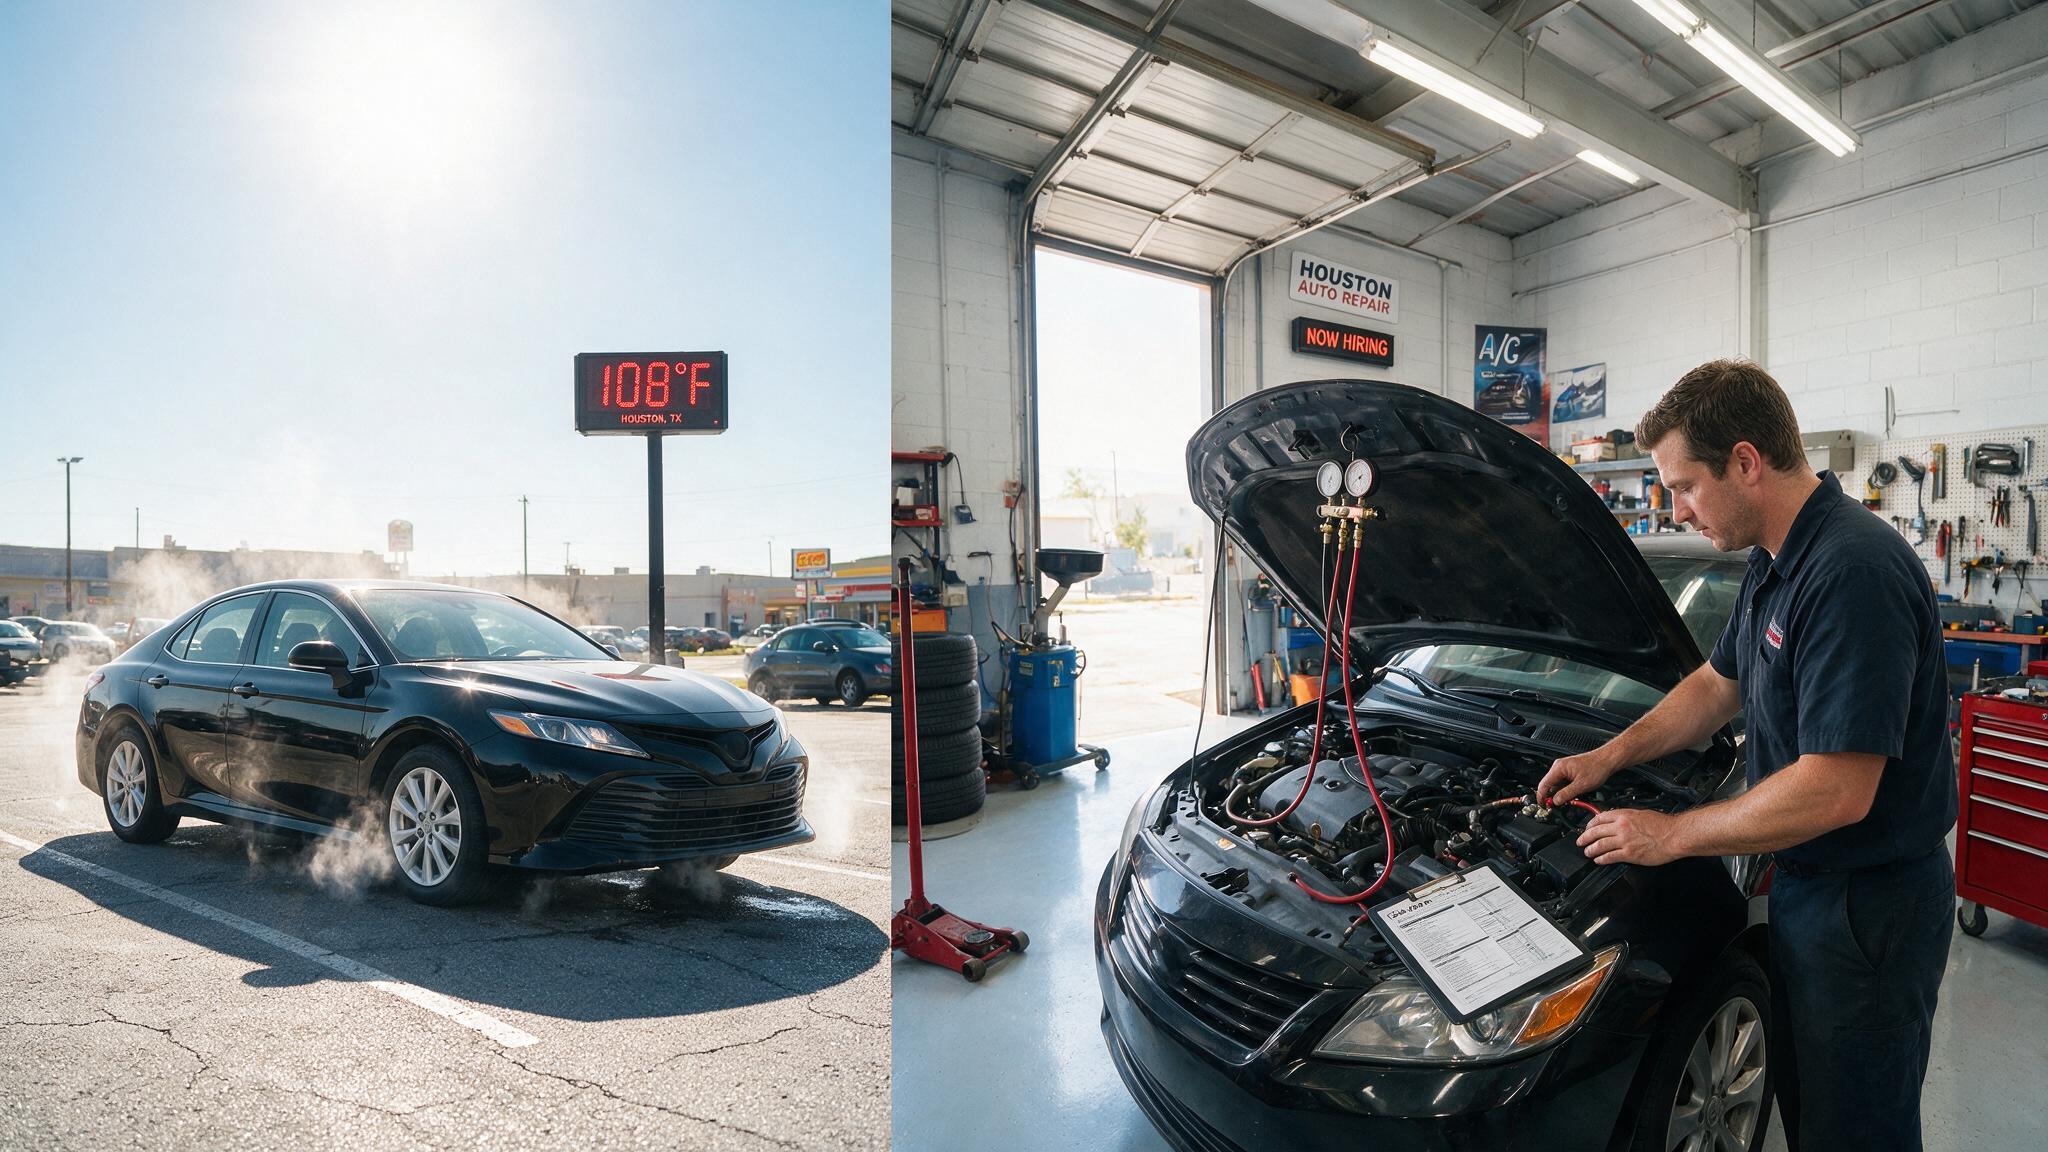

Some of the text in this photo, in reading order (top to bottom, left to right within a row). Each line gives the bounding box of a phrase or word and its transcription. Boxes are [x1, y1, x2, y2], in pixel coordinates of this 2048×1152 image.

[1298, 279, 1390, 314] AUTO REPAIR
[1300, 259, 1392, 300] HOUSTON
[1306, 327, 1388, 356] NOW HIRING
[602, 361, 710, 408] 108°F
[621, 413, 682, 424] HOUSTON, TX
